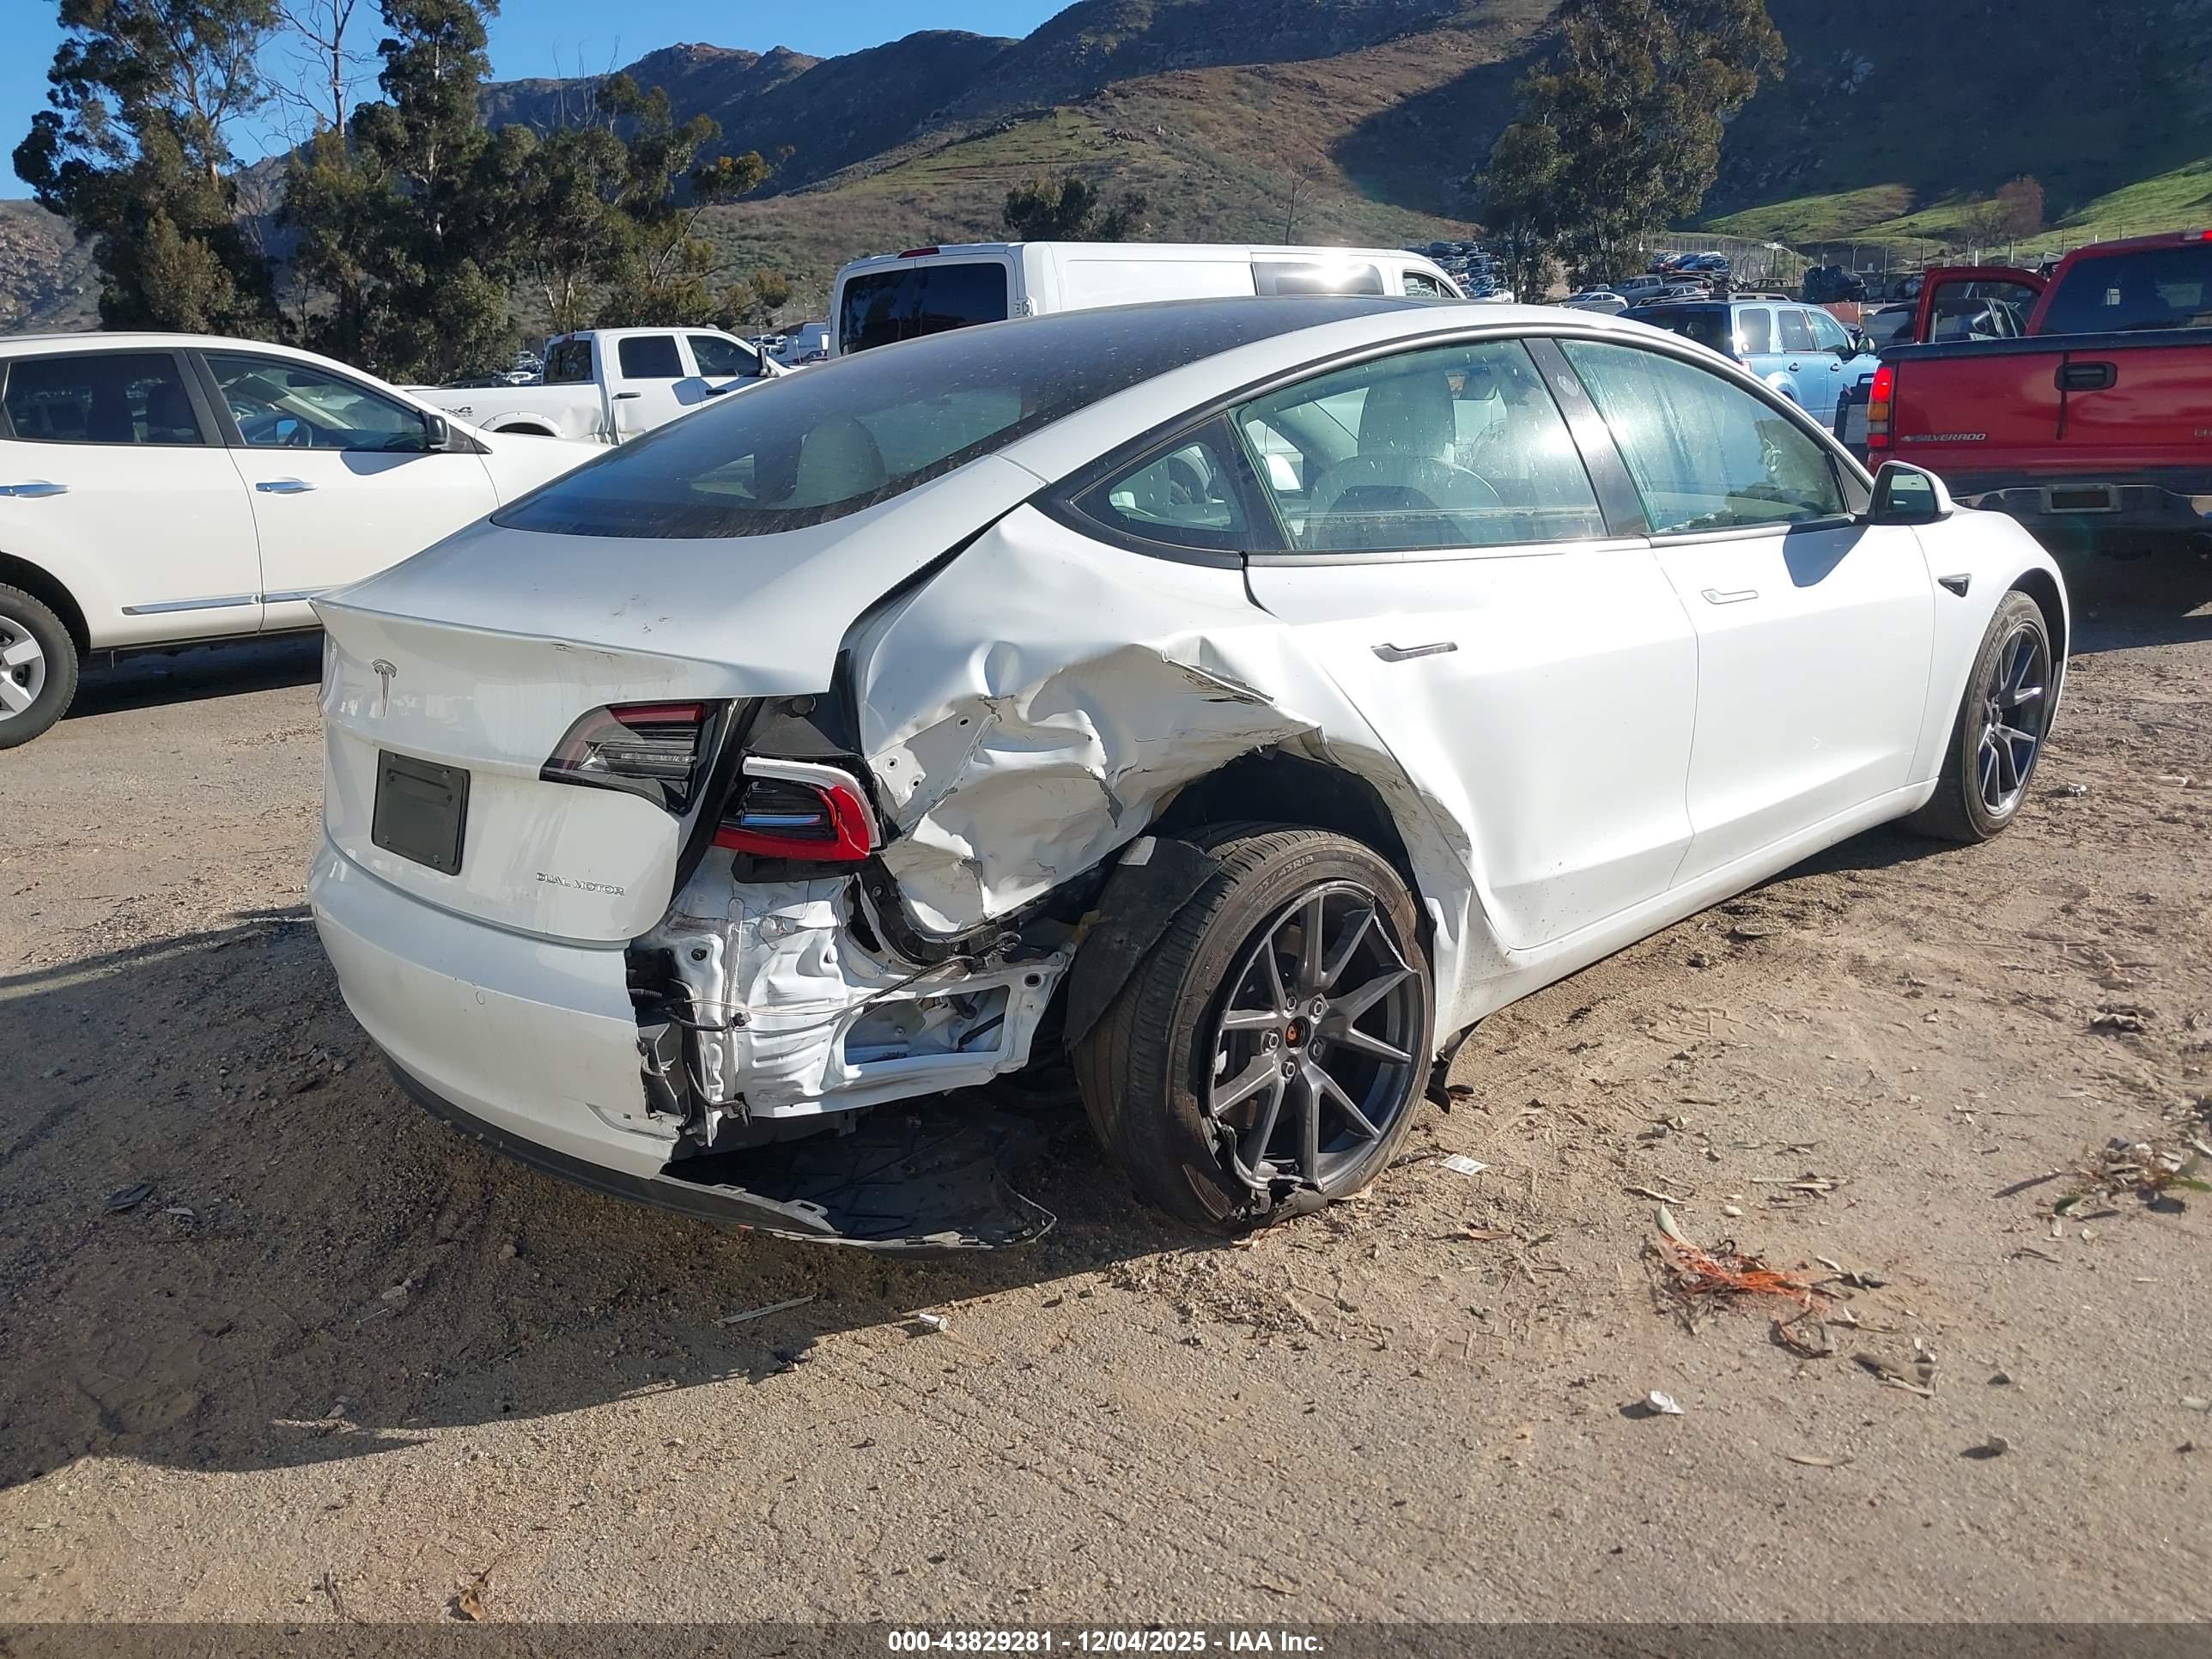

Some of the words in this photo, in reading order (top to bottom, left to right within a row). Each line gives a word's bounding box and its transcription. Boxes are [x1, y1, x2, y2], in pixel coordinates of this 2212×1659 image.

[1915, 433, 1986, 442] SILVERADO
[536, 872, 570, 887] DUAL
[574, 880, 625, 896] MOTOR
